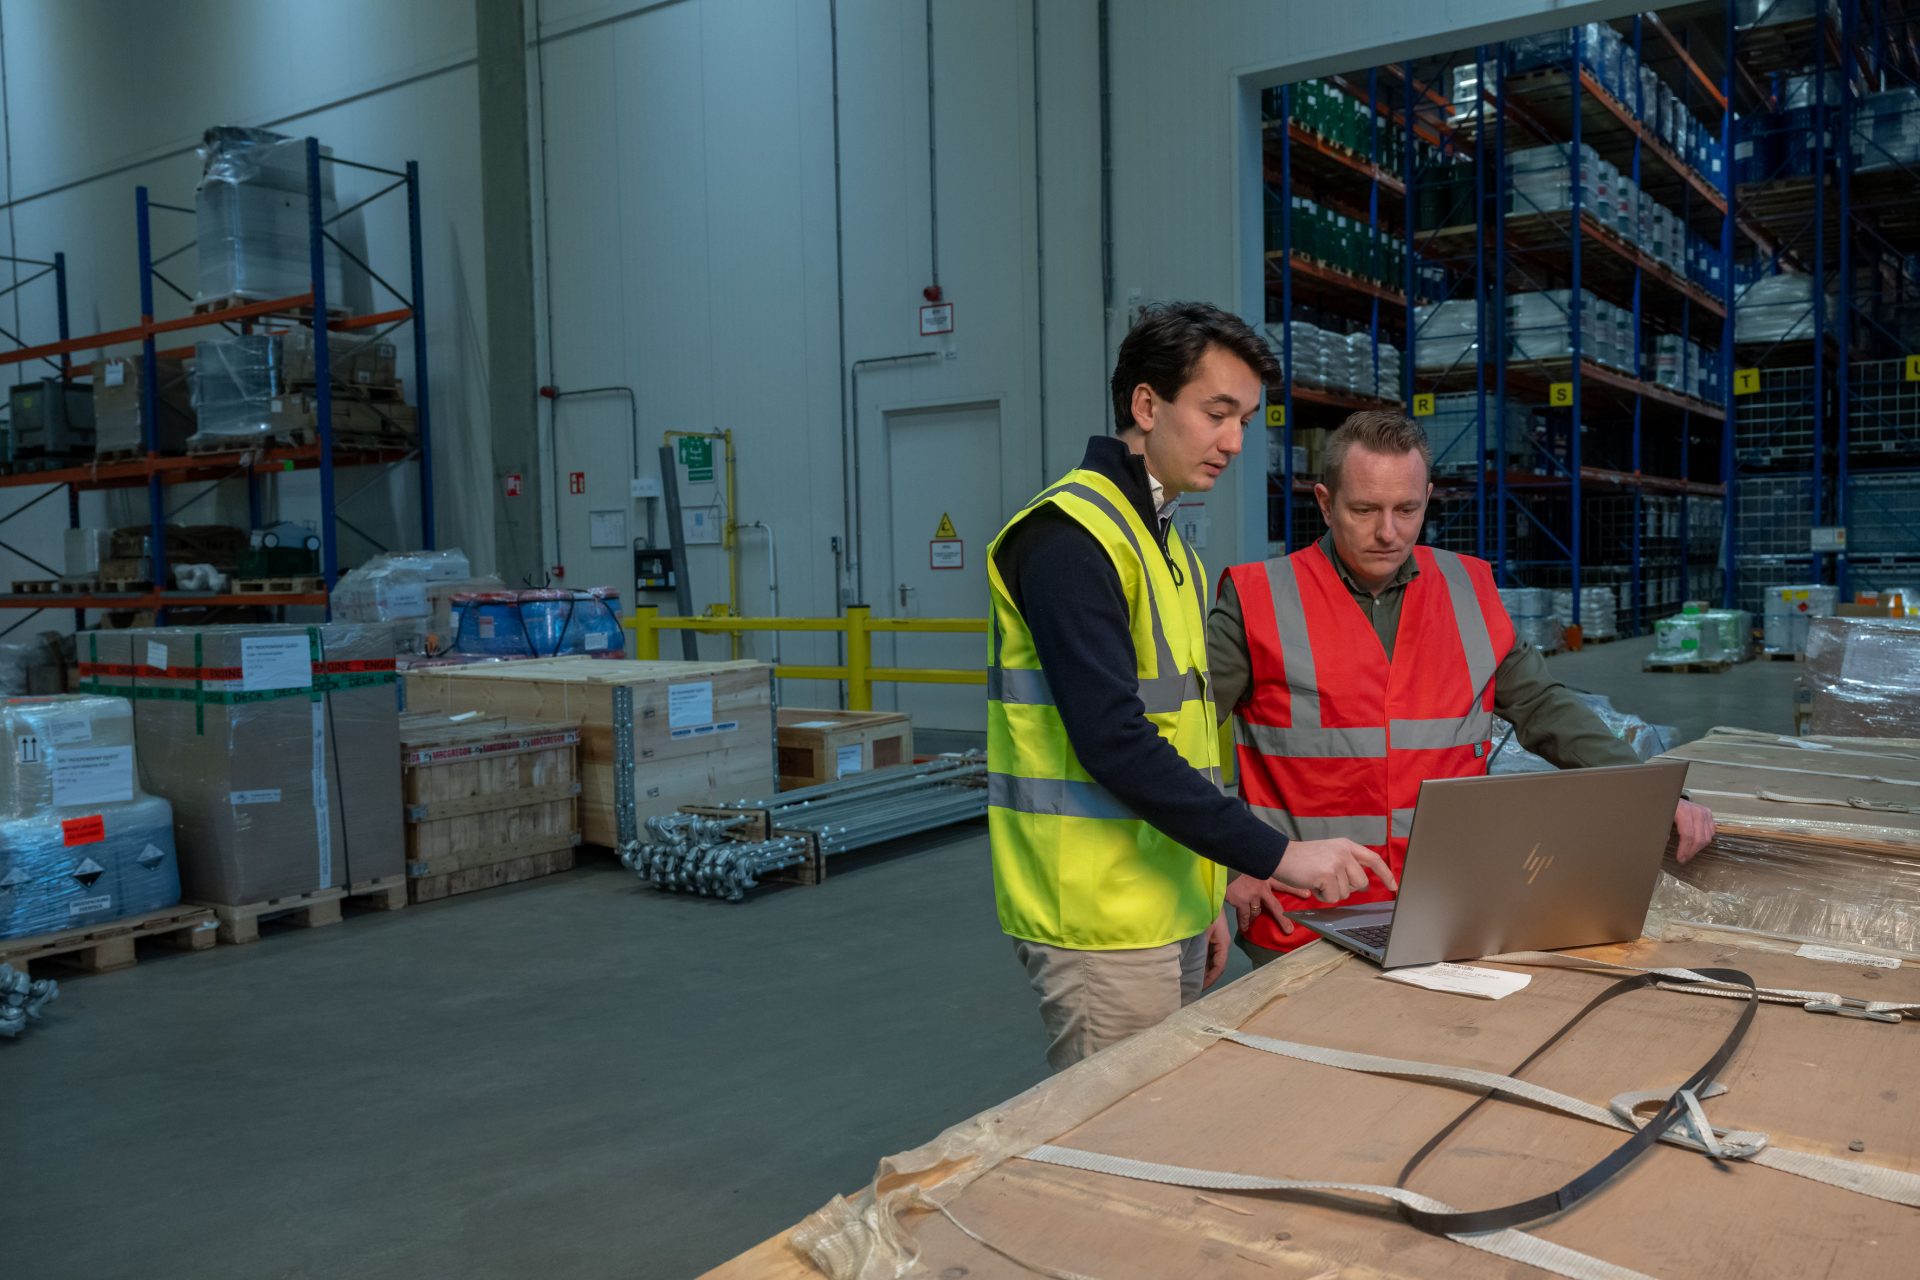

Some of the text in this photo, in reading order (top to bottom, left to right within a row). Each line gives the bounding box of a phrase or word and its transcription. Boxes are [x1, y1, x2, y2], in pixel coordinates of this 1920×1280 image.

[1740, 375, 1751, 388] T
[1556, 388, 1567, 401] S
[1418, 399, 1429, 411] R
[1271, 410, 1282, 423] Q
[233, 690, 264, 703] DECK
